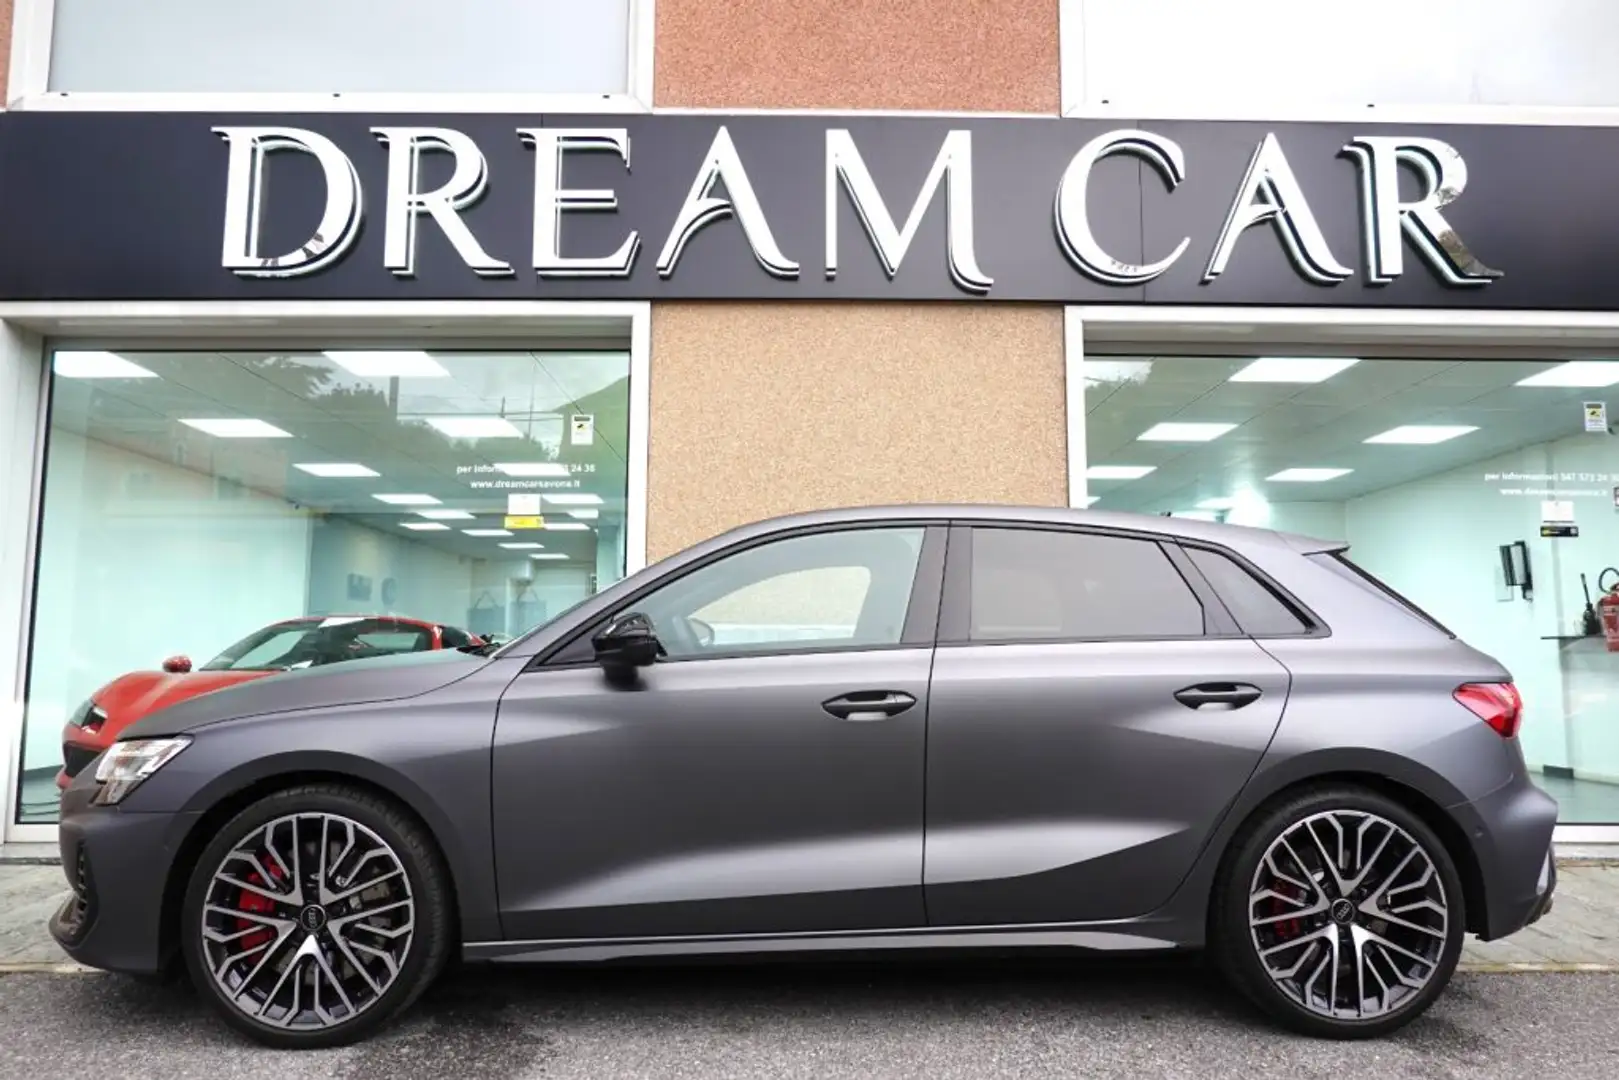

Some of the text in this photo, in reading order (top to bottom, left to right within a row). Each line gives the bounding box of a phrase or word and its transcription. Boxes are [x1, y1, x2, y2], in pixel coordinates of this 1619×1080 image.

[211, 126, 1504, 292] DREAM CAR
[456, 465, 472, 475] per
[470, 479, 580, 489] www.dreamcarsavona.it
